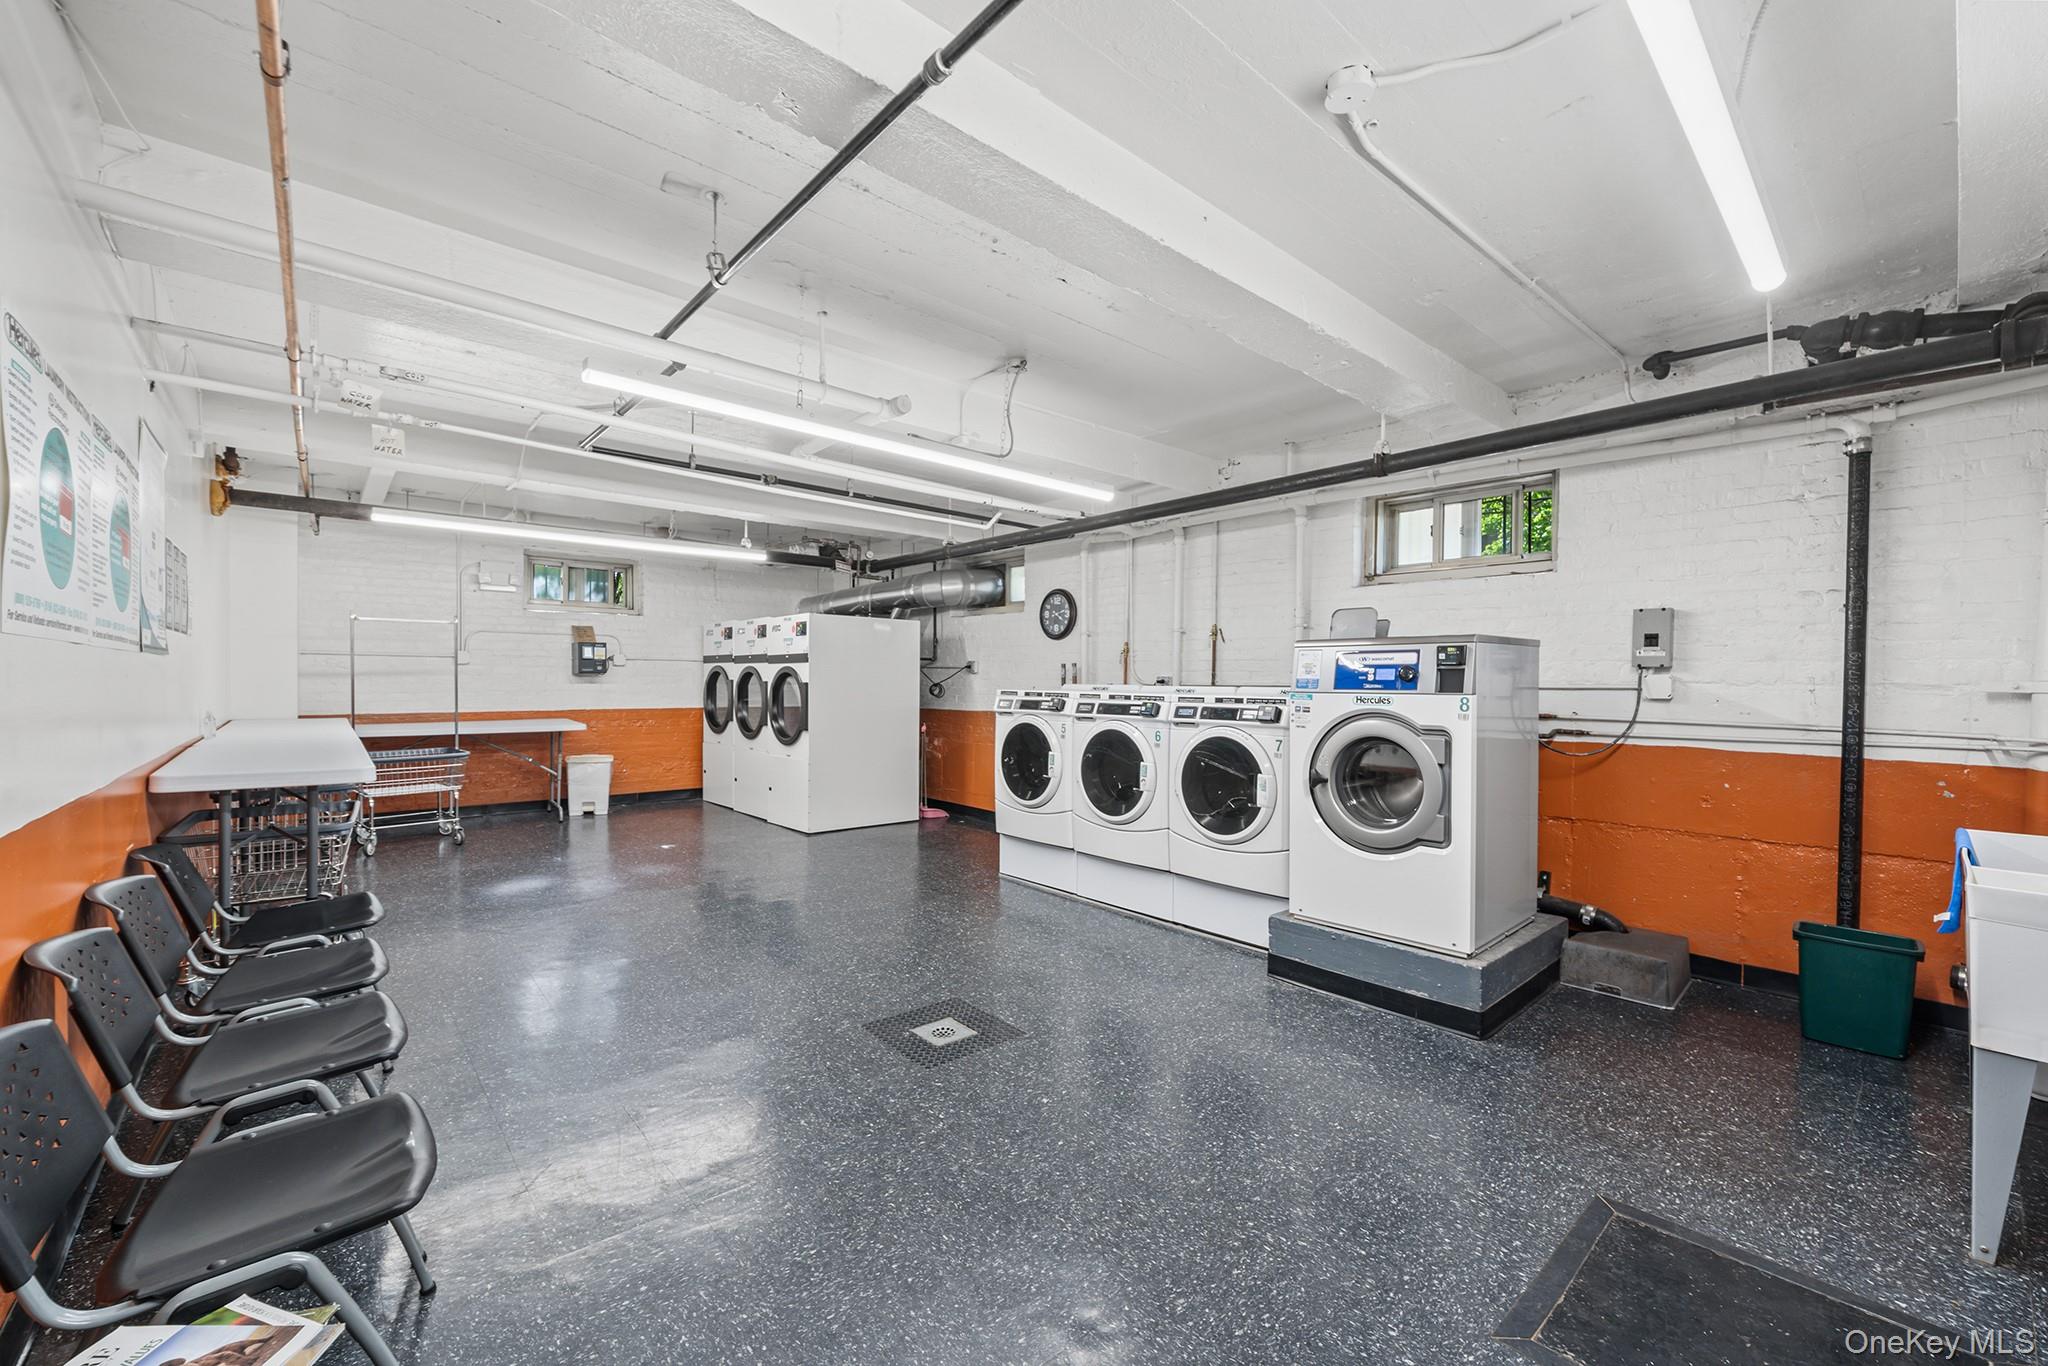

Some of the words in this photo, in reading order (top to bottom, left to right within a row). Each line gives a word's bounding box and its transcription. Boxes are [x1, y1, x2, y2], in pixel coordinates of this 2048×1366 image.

[8, 315, 42, 369] Hercules
[350, 390, 373, 400] COLD
[340, 397, 372, 411] WATER
[373, 446, 404, 456] WATER
[1355, 695, 1392, 705] Hercules
[1459, 696, 1470, 713] 8
[1061, 723, 1067, 734] 5
[1154, 730, 1161, 742] 6
[1275, 739, 1283, 752] 7
